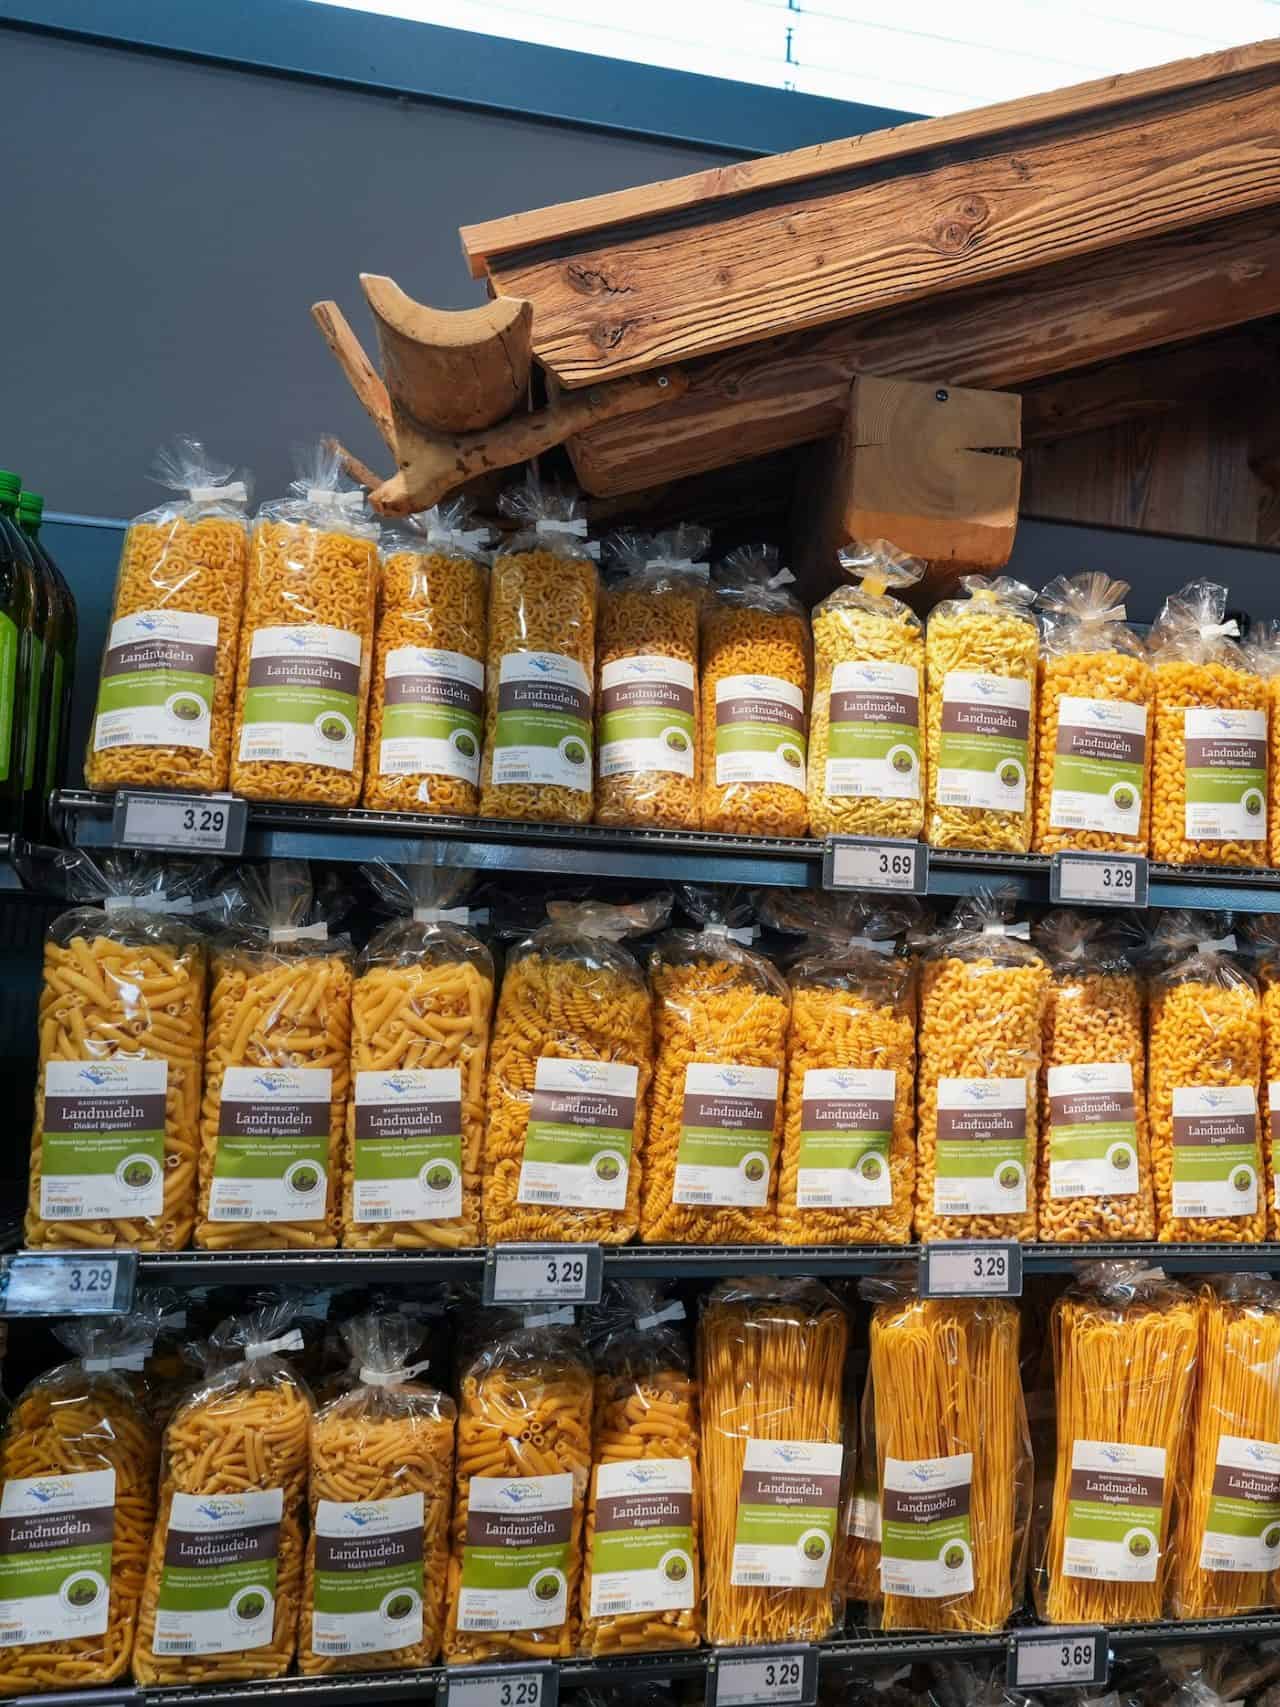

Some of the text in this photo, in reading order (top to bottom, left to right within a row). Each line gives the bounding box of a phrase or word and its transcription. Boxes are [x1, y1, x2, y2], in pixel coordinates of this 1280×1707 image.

[120, 650, 194, 665] Landnudeln
[267, 665, 342, 681] Landnudeln
[401, 684, 471, 702] Landnudeln
[513, 690, 580, 707] Landnudeln
[614, 690, 680, 703] Landnudeln
[731, 705, 794, 721] Landnudeln
[843, 701, 906, 714] Landnudeln
[957, 711, 1018, 729] Landnudeln
[1072, 735, 1132, 753] Landnudeln
[1201, 746, 1257, 759] Landnudeln
[62, 1106, 145, 1120] Landnudeln
[550, 1101, 619, 1117] Landnudeln
[699, 1104, 763, 1120] Landnudeln
[815, 1108, 880, 1121] Landnudeln
[1063, 1102, 1121, 1114] Landnudeln
[236, 1111, 313, 1125] Landnudeln
[370, 1112, 443, 1127] Landnudeln
[951, 1118, 1014, 1130] Landnudeln
[246, 1127, 272, 1135] Dinkel
[1188, 1124, 1246, 1137] Landnudeln
[757, 1481, 823, 1496] Landnudeln
[1086, 1480, 1149, 1497] Landnudeln
[612, 1503, 680, 1519] Landnudeln
[896, 1498, 957, 1513] Landnudeln
[10, 1520, 91, 1541] Landnudeln
[485, 1521, 556, 1536] Landnudeln
[179, 1537, 259, 1556] Landnudeln
[329, 1542, 405, 1560] Landnudeln
